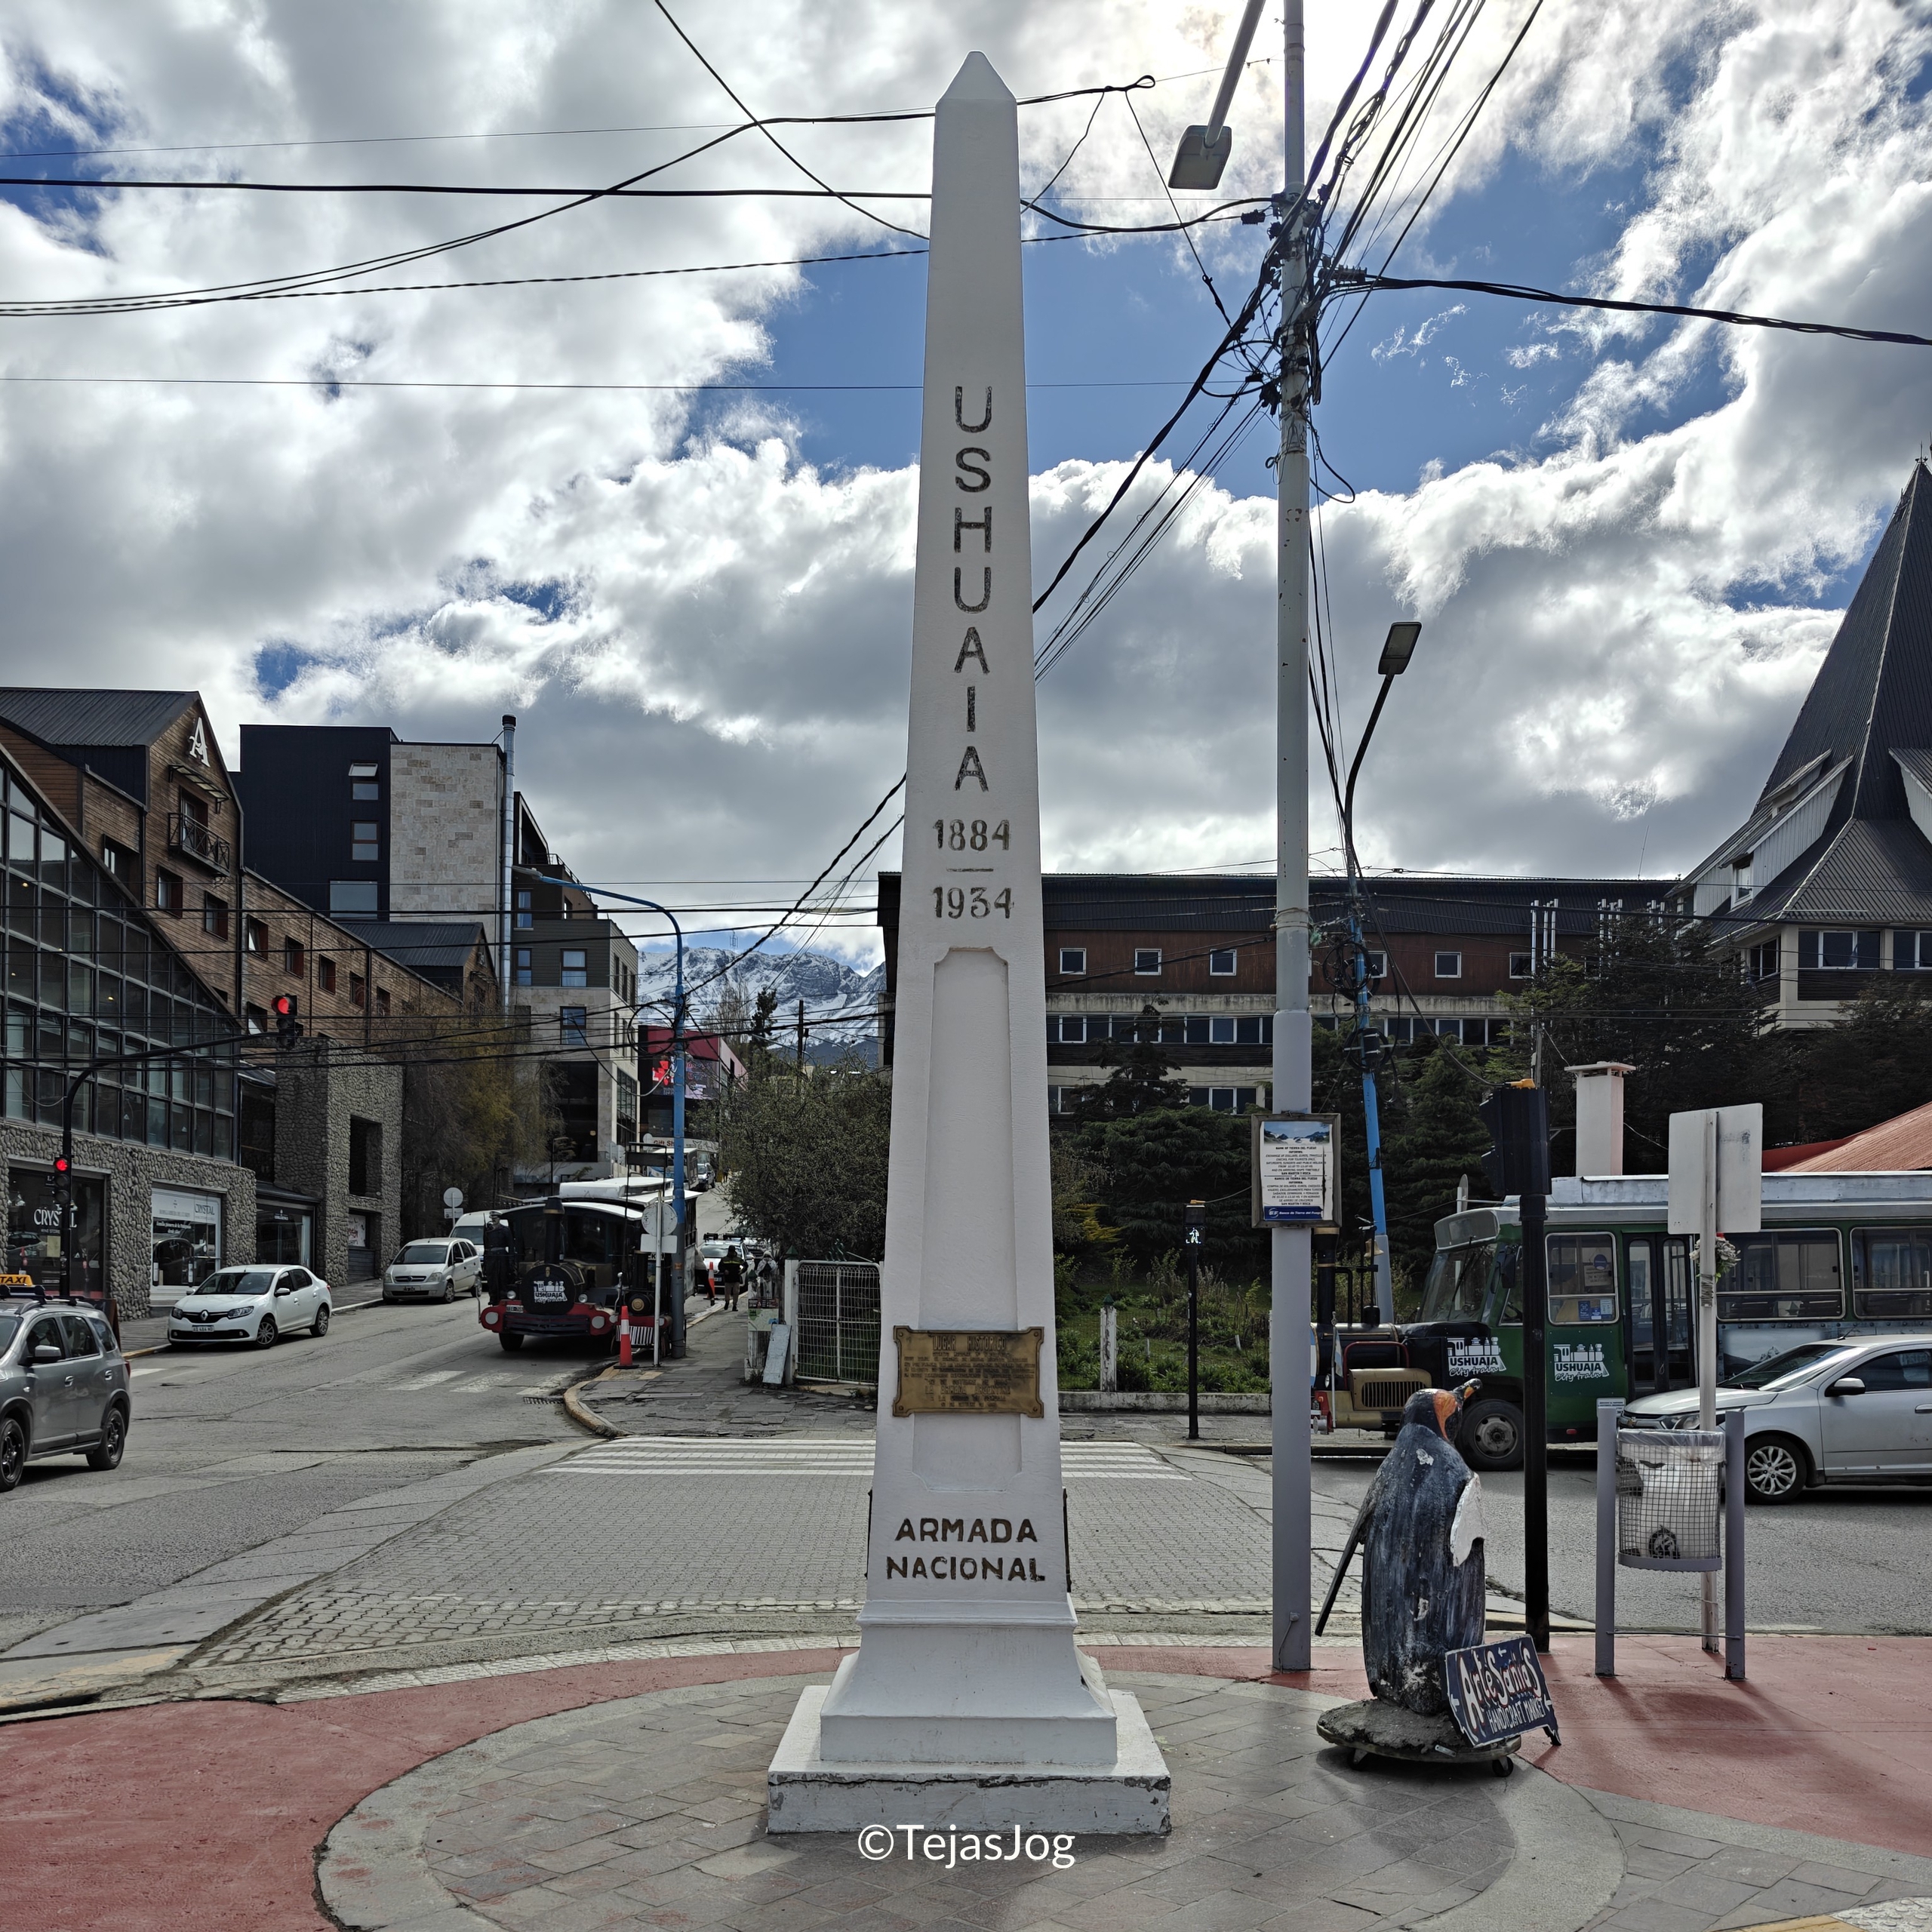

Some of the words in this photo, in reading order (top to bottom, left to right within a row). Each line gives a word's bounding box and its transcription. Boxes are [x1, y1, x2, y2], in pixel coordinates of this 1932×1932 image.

[953, 386, 992, 792] USHUAIA
[933, 819, 1011, 851] 1884
[931, 886, 1013, 919] 1934
[34, 1209, 77, 1228] CRYSL
[1449, 1367, 1469, 1377] City
[1472, 1366, 1499, 1375] train
[1450, 1357, 1498, 1366] USHUAIA
[1555, 1363, 1601, 1371] USHUAIA
[1555, 1372, 1574, 1383] City
[894, 1518, 1038, 1543] ARMADA
[886, 1556, 1046, 1582] NACIONAL
[1486, 1700, 1526, 1734] HANDICRAFT
[1523, 1697, 1546, 1724] MARKET
